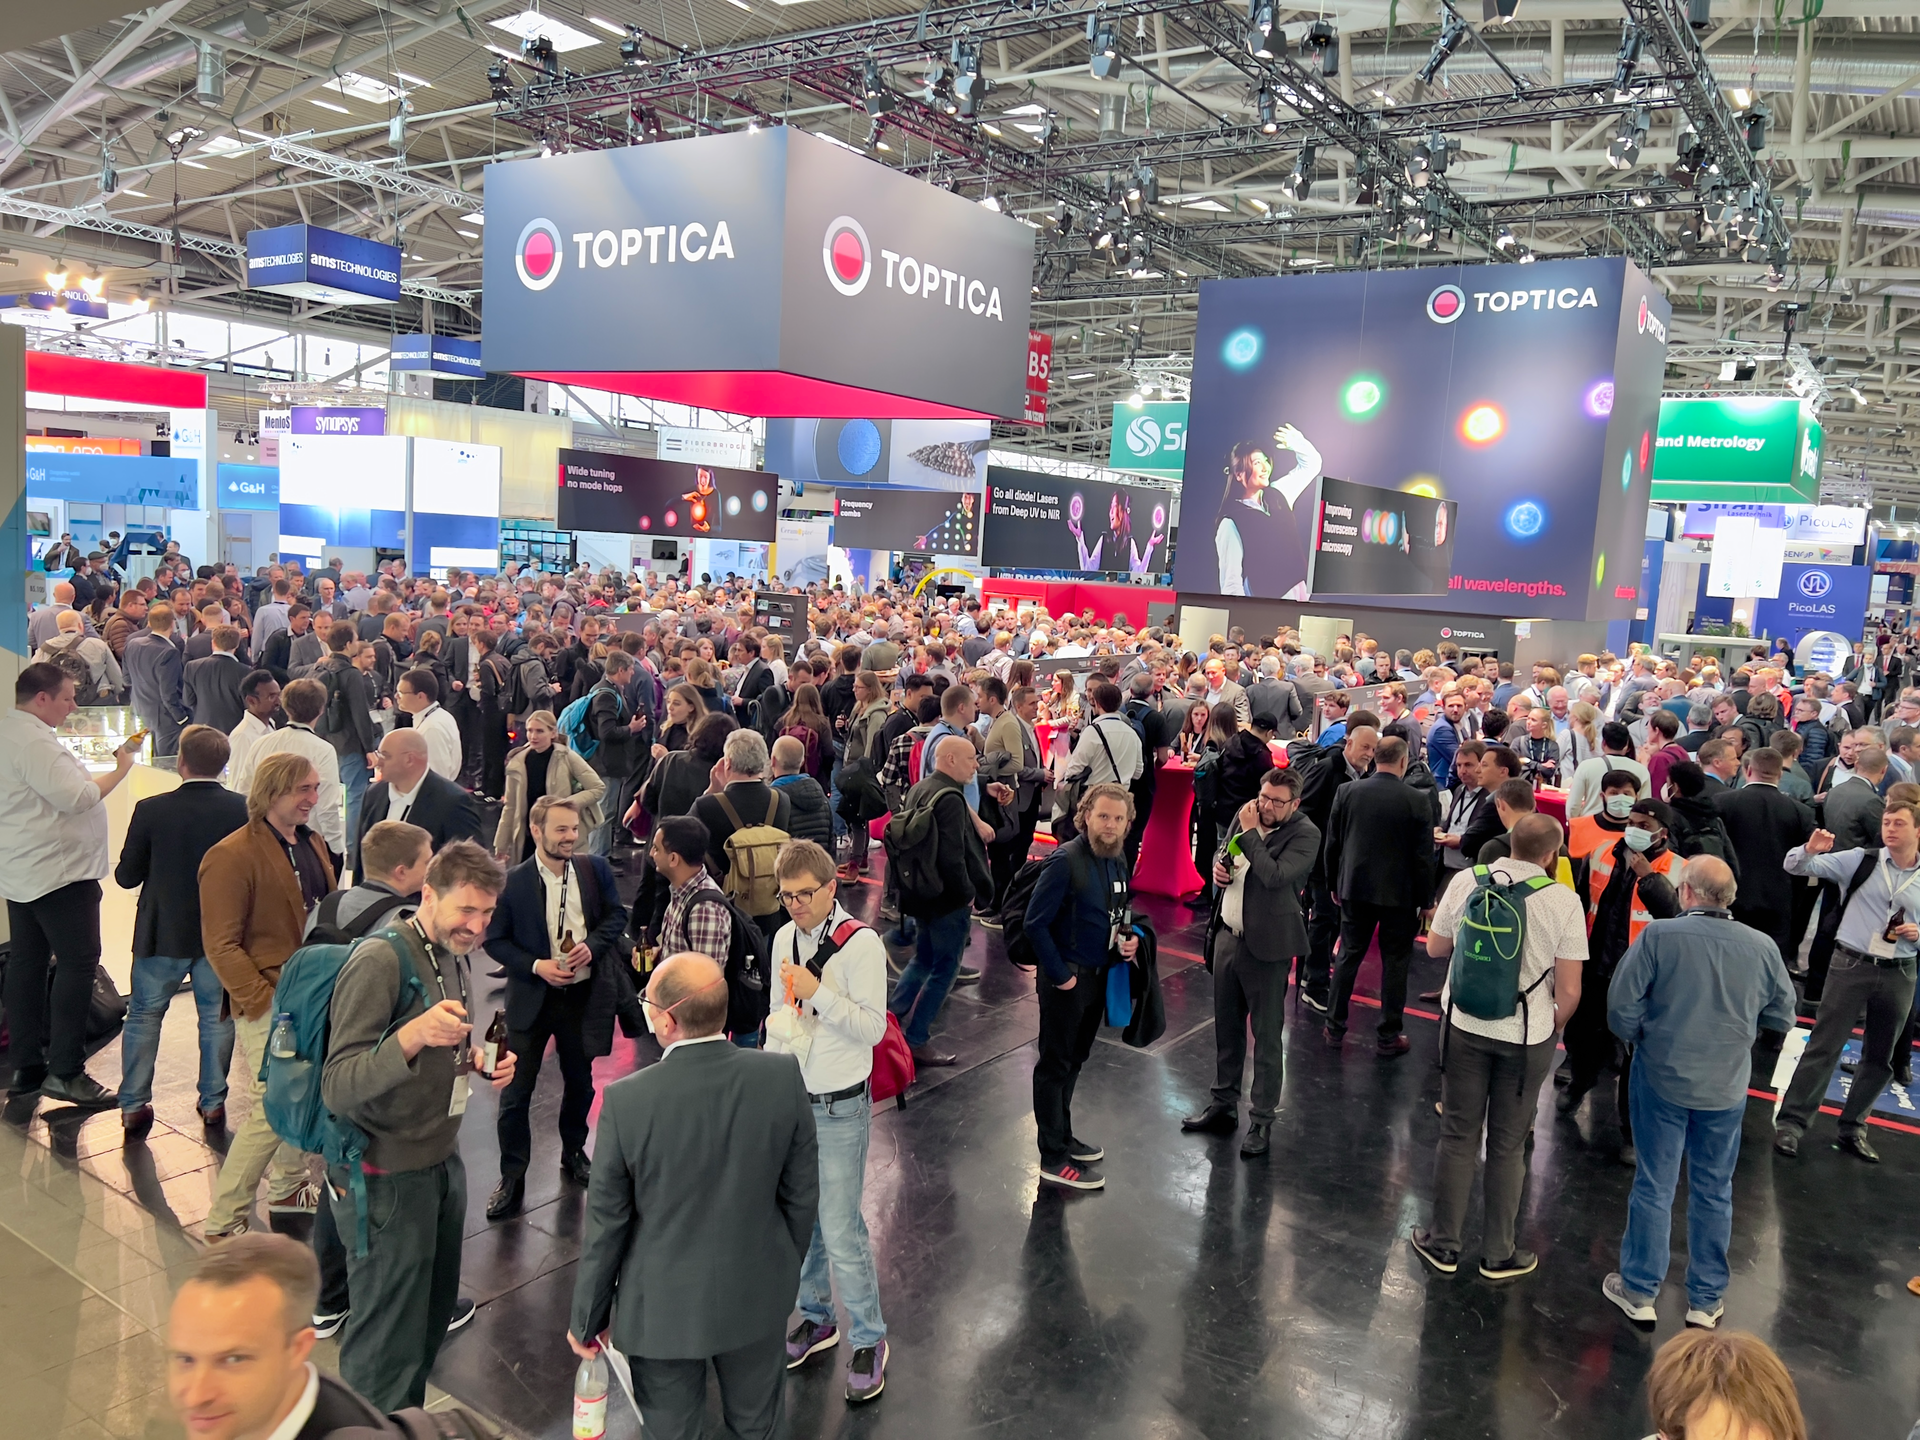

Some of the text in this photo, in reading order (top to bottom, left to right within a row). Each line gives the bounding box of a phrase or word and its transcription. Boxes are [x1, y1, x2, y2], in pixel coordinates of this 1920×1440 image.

[572, 220, 735, 269] TOPTICA
[248, 252, 304, 269] amsTECHNOLOGIES
[310, 253, 398, 284] amsTECHNOLOGIES
[881, 249, 1003, 322] TOPTICA
[1473, 287, 1599, 313] TOPTICA
[1646, 310, 1666, 346] TOPTICA
[1028, 351, 1049, 379] B5
[1686, 435, 1766, 452] Metrology
[29, 467, 46, 481] G&H
[567, 465, 616, 481] Wide tuning
[239, 481, 265, 494] G&H
[567, 480, 623, 494] no mode hops
[993, 486, 1005, 499] Go
[1005, 488, 1014, 500] all
[1036, 491, 1059, 505] Lasers
[840, 499, 874, 510] Frequency
[992, 503, 1010, 515] from
[1010, 504, 1029, 520] Deep
[1029, 507, 1040, 518] UV
[1040, 508, 1048, 519] to
[840, 510, 861, 518] combs
[1799, 514, 1854, 530] PicoLAS
[1464, 578, 1567, 598] wavelengths.
[1788, 602, 1836, 614] PicoLAS
[1453, 630, 1485, 639] TOPTICA
